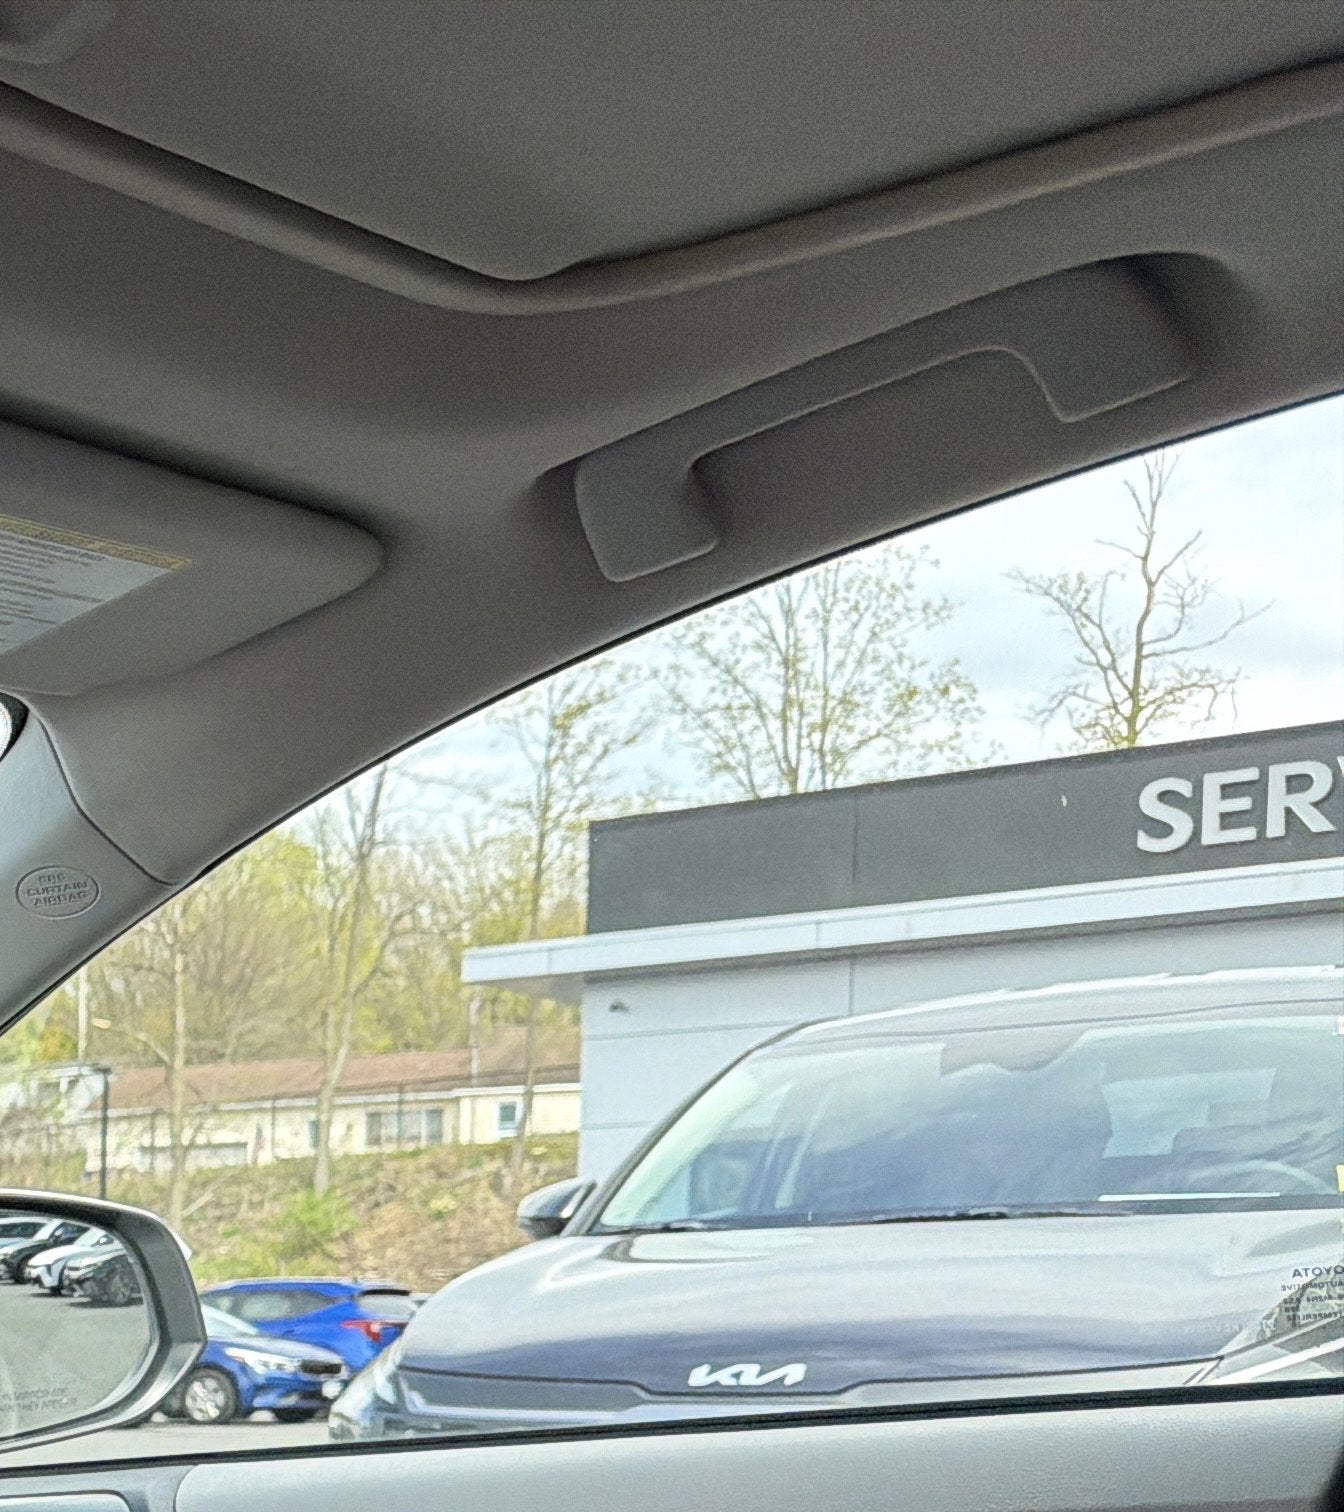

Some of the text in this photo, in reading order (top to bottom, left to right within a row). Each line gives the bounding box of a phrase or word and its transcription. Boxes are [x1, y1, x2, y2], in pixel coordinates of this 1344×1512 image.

[1137, 756, 1344, 853] SER
[26, 880, 88, 896] CURTAIN
[34, 891, 89, 908] AIRBAG
